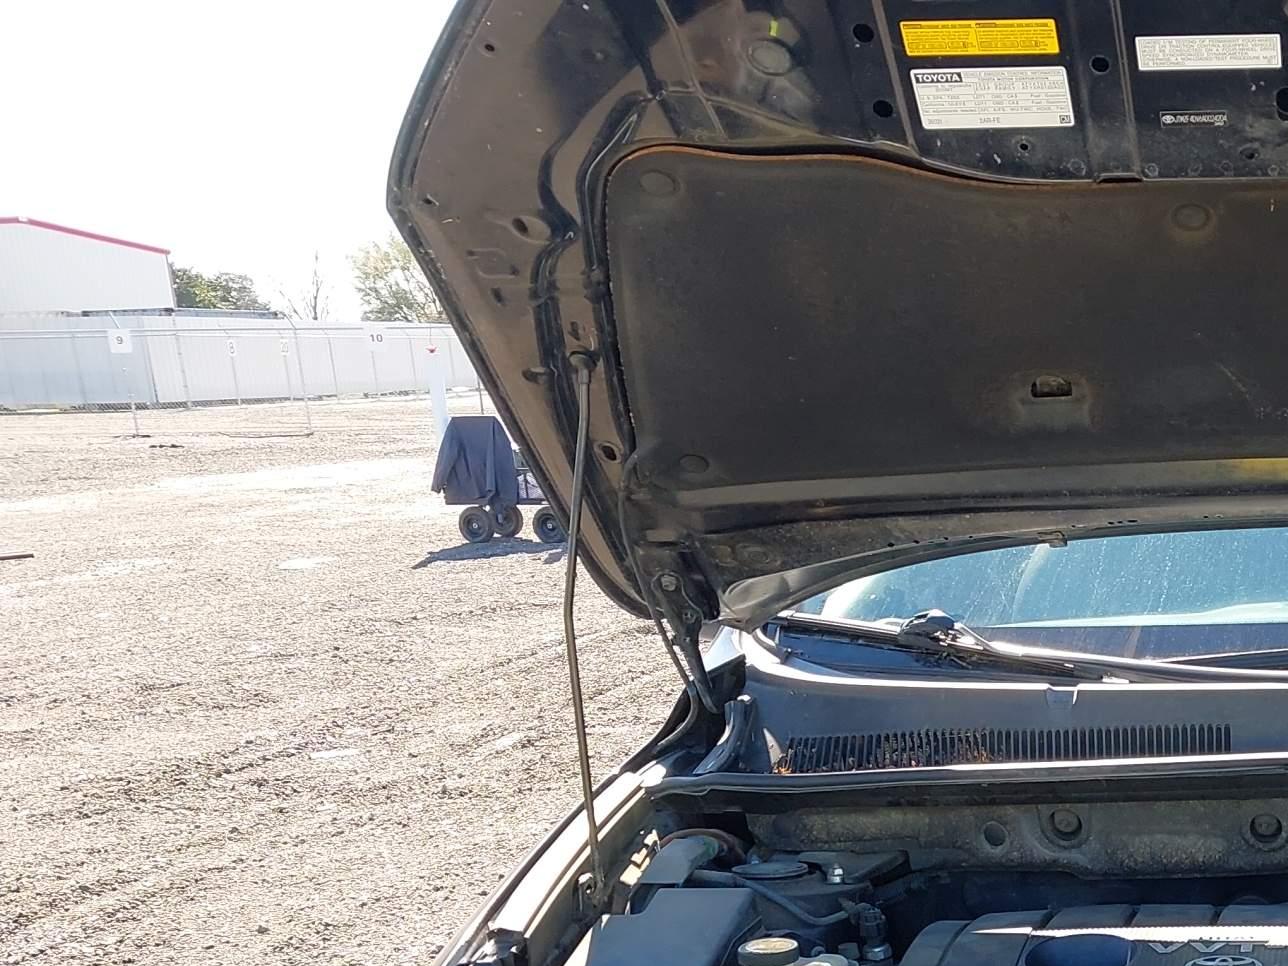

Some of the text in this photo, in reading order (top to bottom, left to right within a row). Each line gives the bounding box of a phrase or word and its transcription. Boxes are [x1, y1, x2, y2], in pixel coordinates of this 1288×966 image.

[915, 73, 960, 82] TOYOTA
[115, 335, 124, 345] 9
[369, 334, 383, 343] 10
